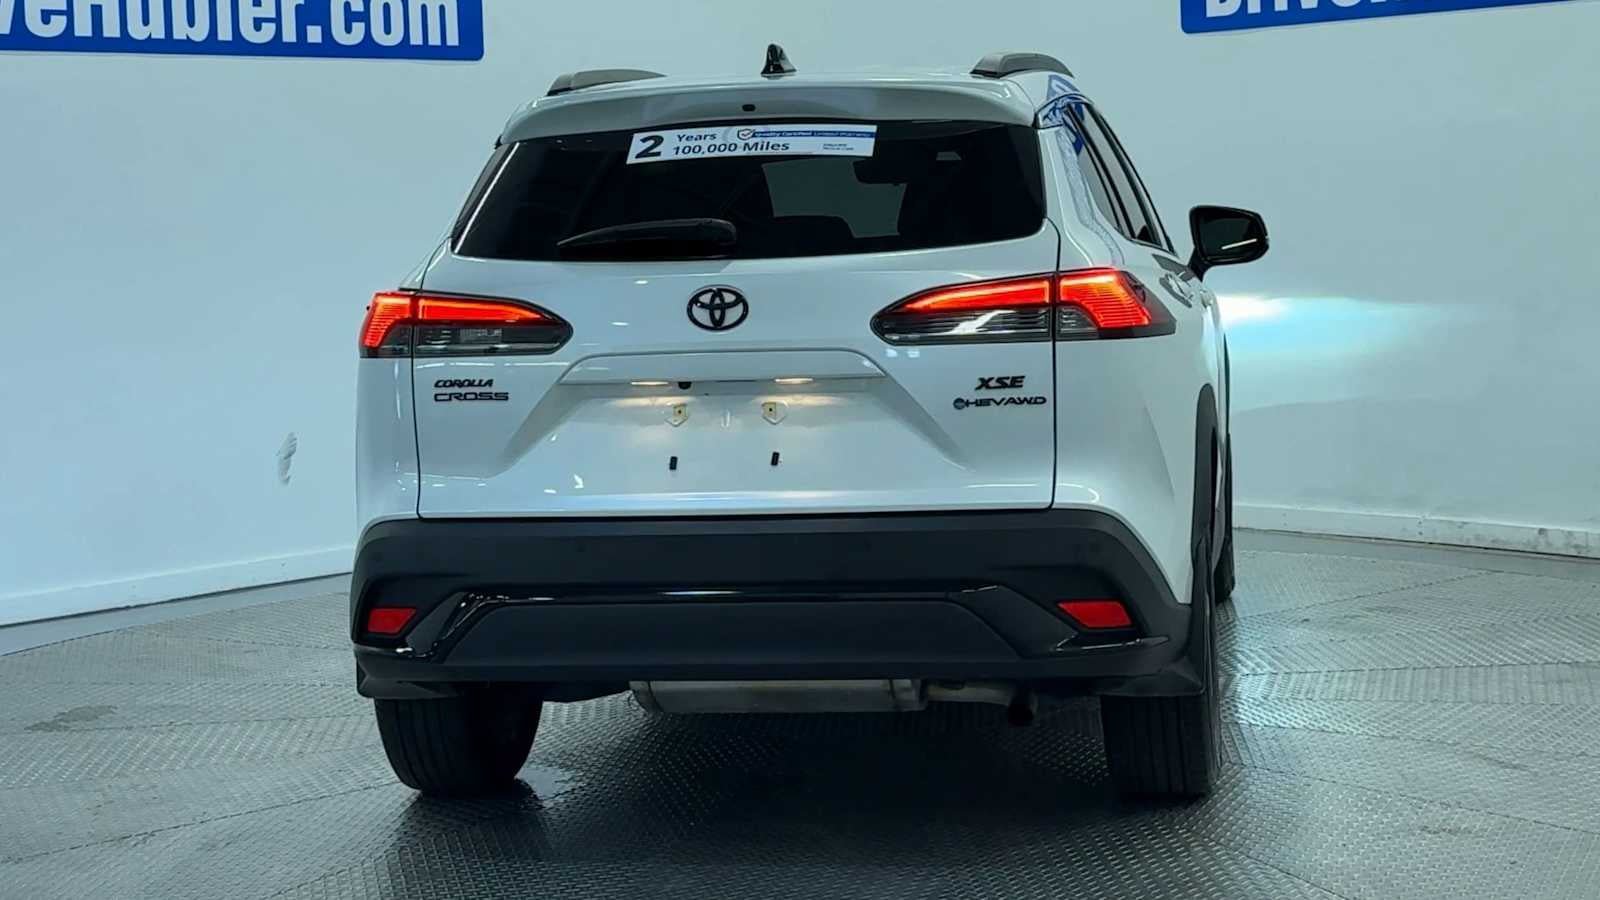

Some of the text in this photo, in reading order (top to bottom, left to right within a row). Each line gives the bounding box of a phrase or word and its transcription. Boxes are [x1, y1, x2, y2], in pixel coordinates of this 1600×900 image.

[677, 131, 717, 143] Years
[634, 135, 665, 159] 2
[673, 140, 790, 156] 100,000 Miles
[434, 379, 494, 388] COROLLA
[975, 375, 1026, 391] XSE
[434, 392, 509, 402] CROSS
